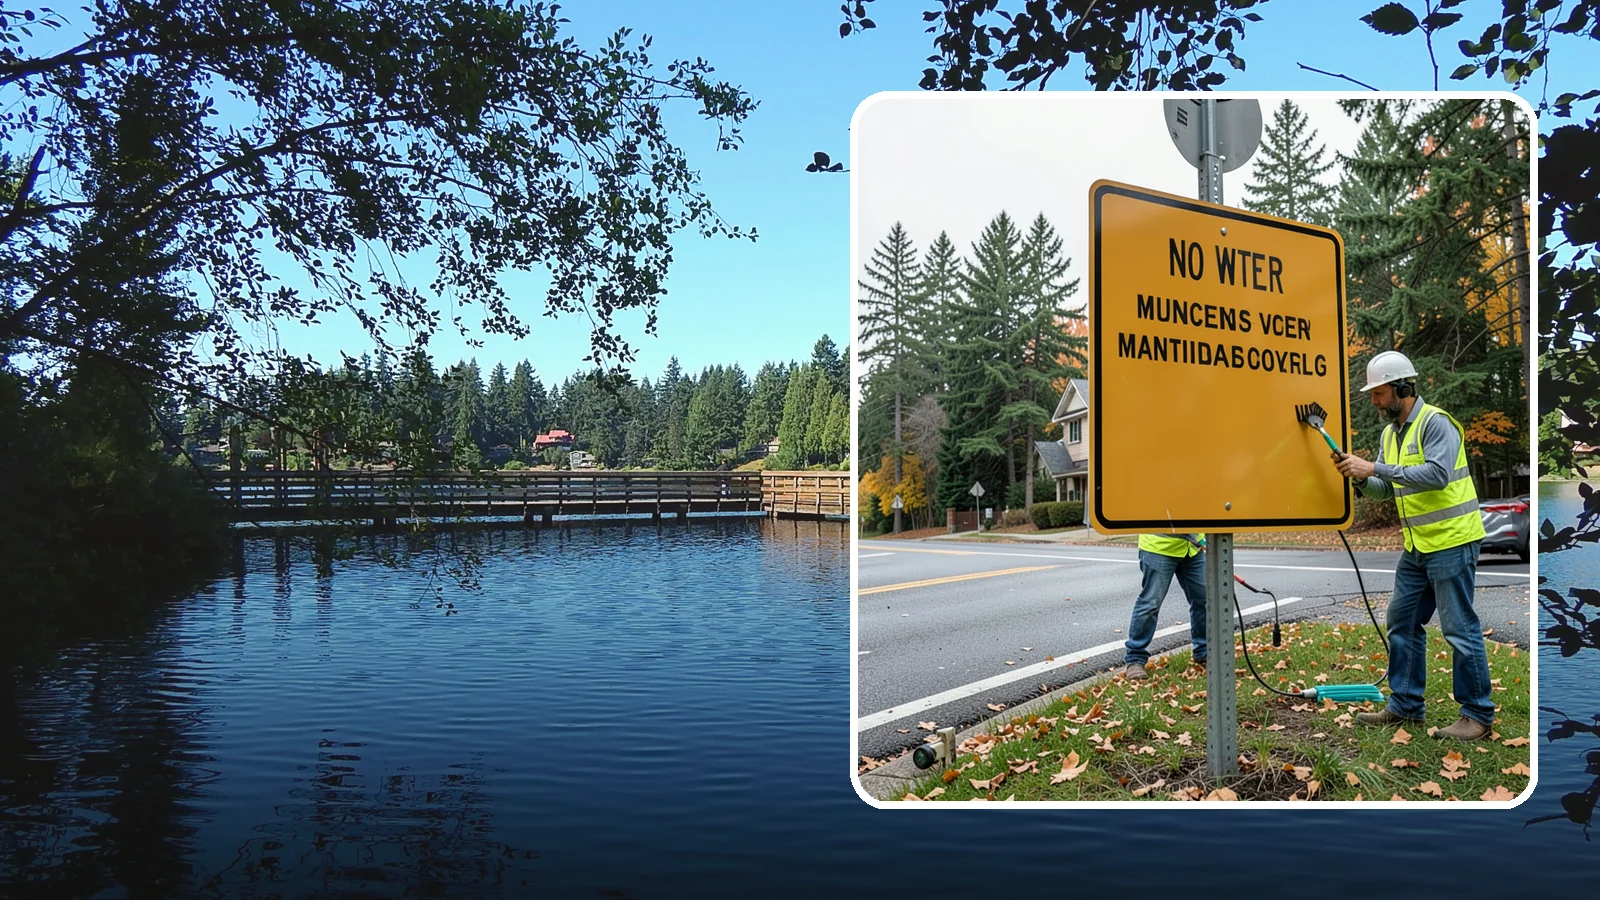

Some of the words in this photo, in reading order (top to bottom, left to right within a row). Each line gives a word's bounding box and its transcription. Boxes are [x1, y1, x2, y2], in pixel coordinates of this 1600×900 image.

[1169, 237, 1204, 281] NO
[1215, 245, 1284, 294] WTER
[1137, 294, 1252, 333] MUNCENS
